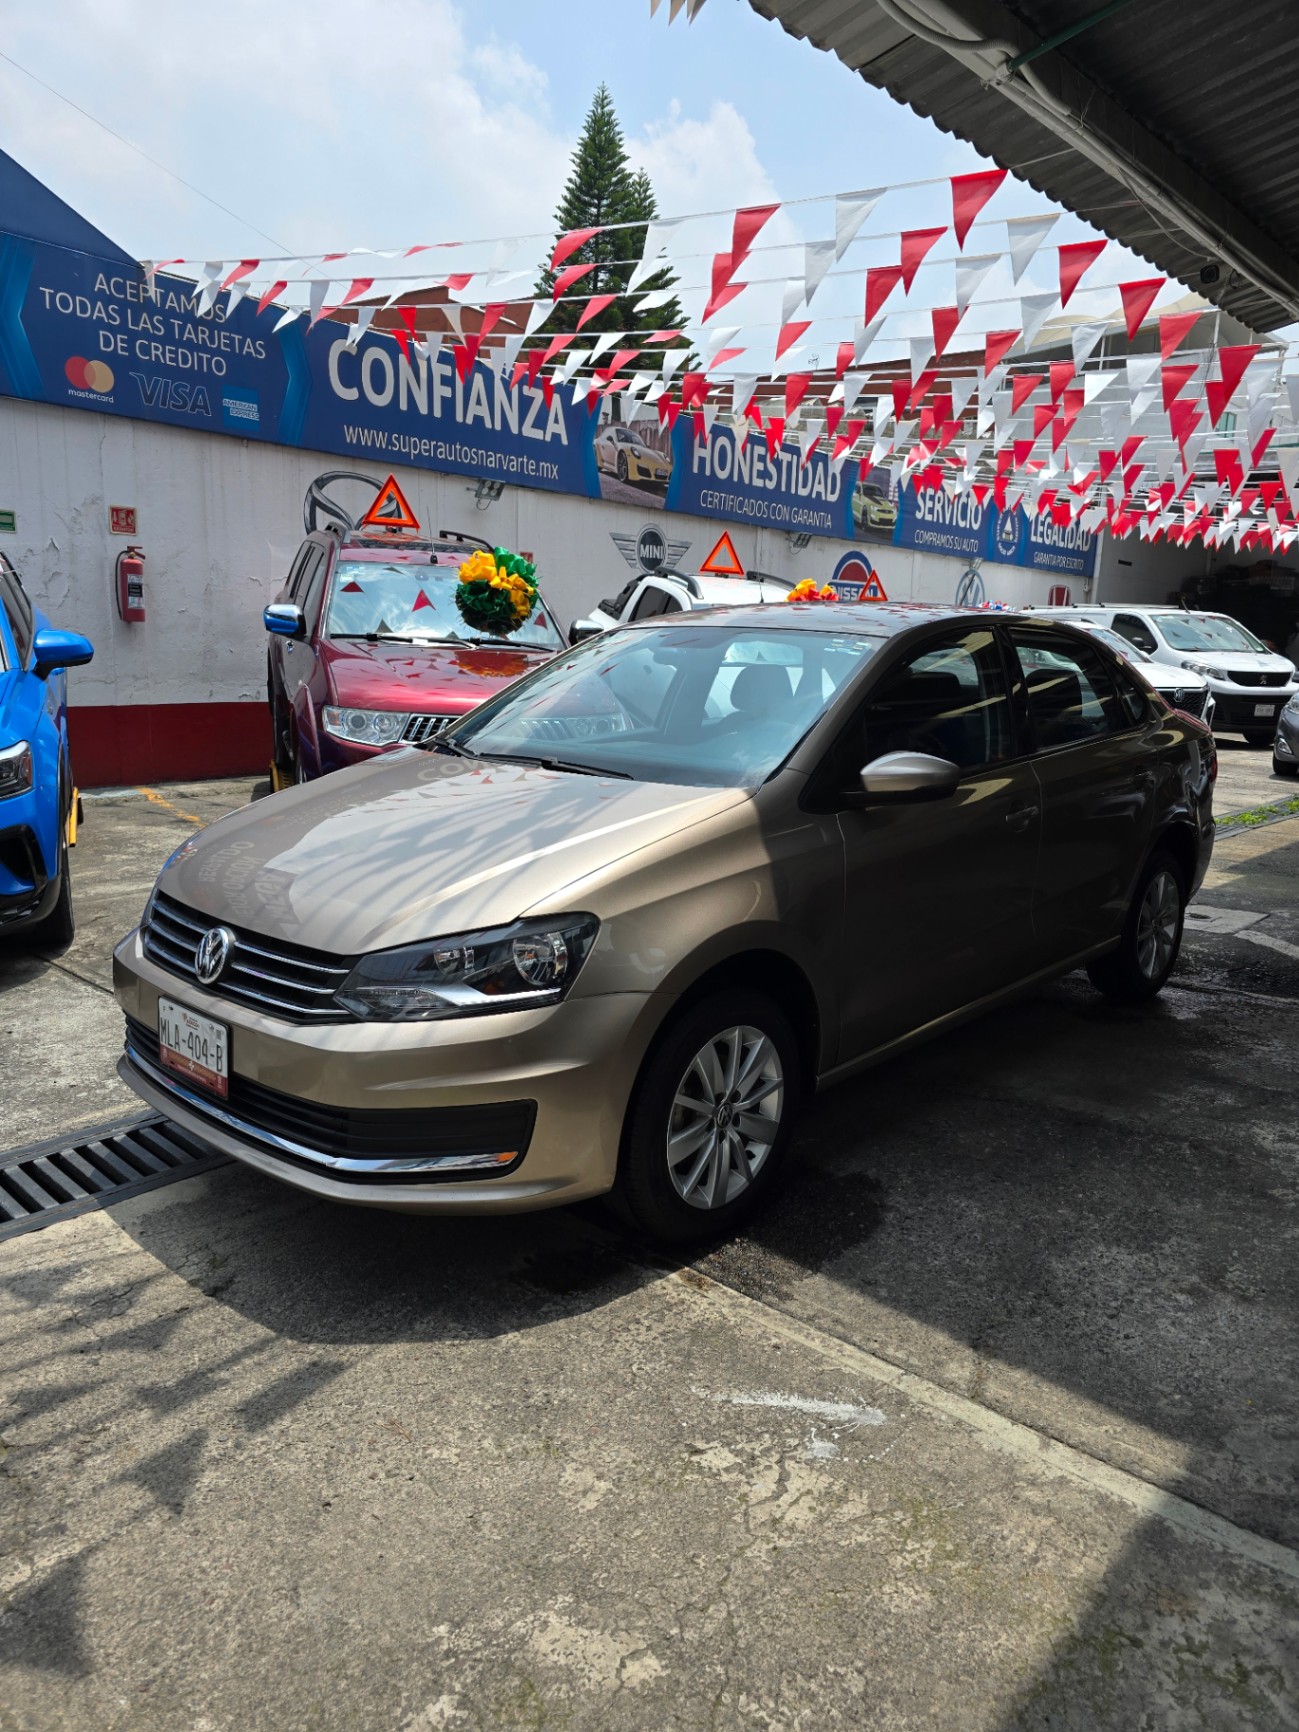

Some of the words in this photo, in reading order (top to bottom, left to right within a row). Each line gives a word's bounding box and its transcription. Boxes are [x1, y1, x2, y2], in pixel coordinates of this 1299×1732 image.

[39, 286, 121, 326] TODAS
[127, 308, 165, 336] LAS
[169, 318, 267, 359] TARJETAS
[99, 330, 129, 356] DE
[135, 339, 227, 376] CREDITO
[68, 388, 114, 404] mastercard
[128, 371, 212, 417] VISA
[328, 338, 569, 446] CONFIANZA
[343, 424, 559, 480] www.superautosnarvarte.mx
[692, 432, 842, 503] HONESTIDAD
[700, 489, 769, 519] CERTIFICADOS
[769, 502, 791, 522] CON
[791, 507, 832, 529] GARANTIA
[915, 484, 982, 531] SERVICIO
[640, 543, 664, 560] MINI
[914, 529, 954, 549] COMPRAMOS
[953, 536, 962, 550] SU
[962, 539, 979, 553] AUTO
[1030, 513, 1091, 552] LEGALIDAD
[830, 585, 874, 601] NISSN
[160, 1017, 224, 1073] MLA-404-B
